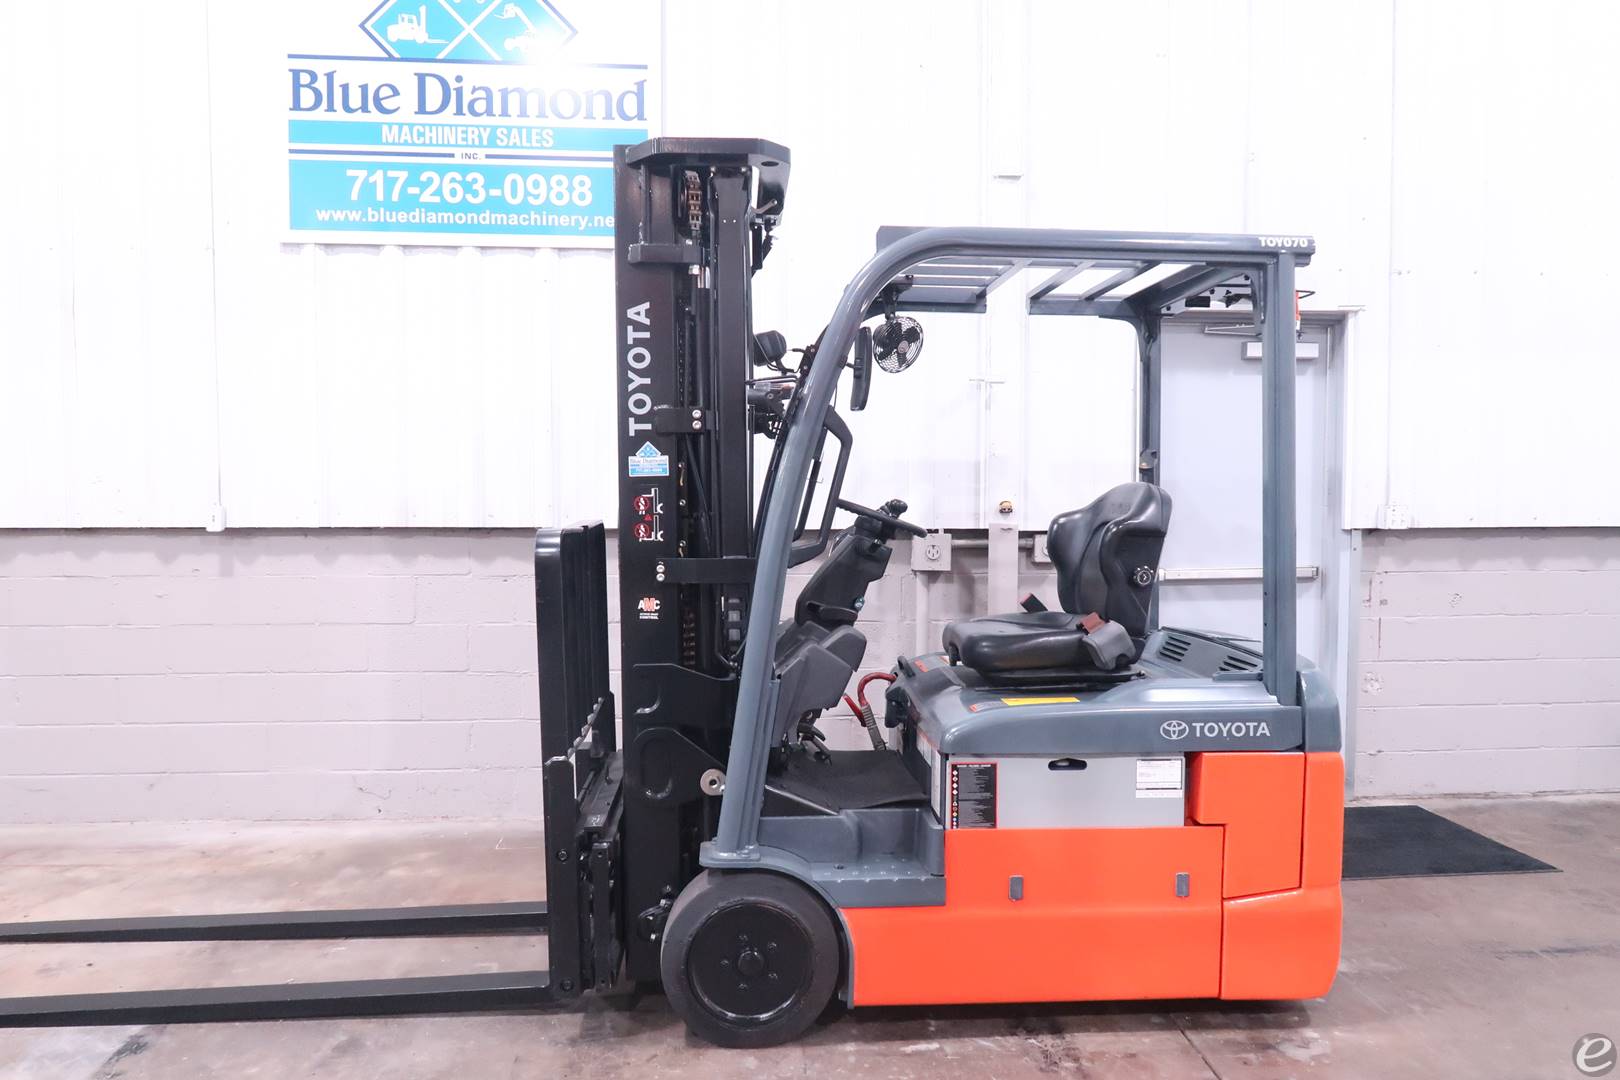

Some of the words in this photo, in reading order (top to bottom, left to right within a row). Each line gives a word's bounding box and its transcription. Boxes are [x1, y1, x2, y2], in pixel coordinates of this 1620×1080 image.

[288, 68, 401, 115] Blue
[413, 72, 648, 122] Diamond
[381, 123, 491, 146] MACHINERY
[495, 127, 555, 148] SALES
[461, 152, 481, 160] INC.
[345, 168, 593, 207] 717-263-0988
[315, 206, 615, 229] www.bluediamondmachinery.ne
[626, 301, 652, 437] TOYOTA
[1192, 721, 1271, 738] TOYOTA
